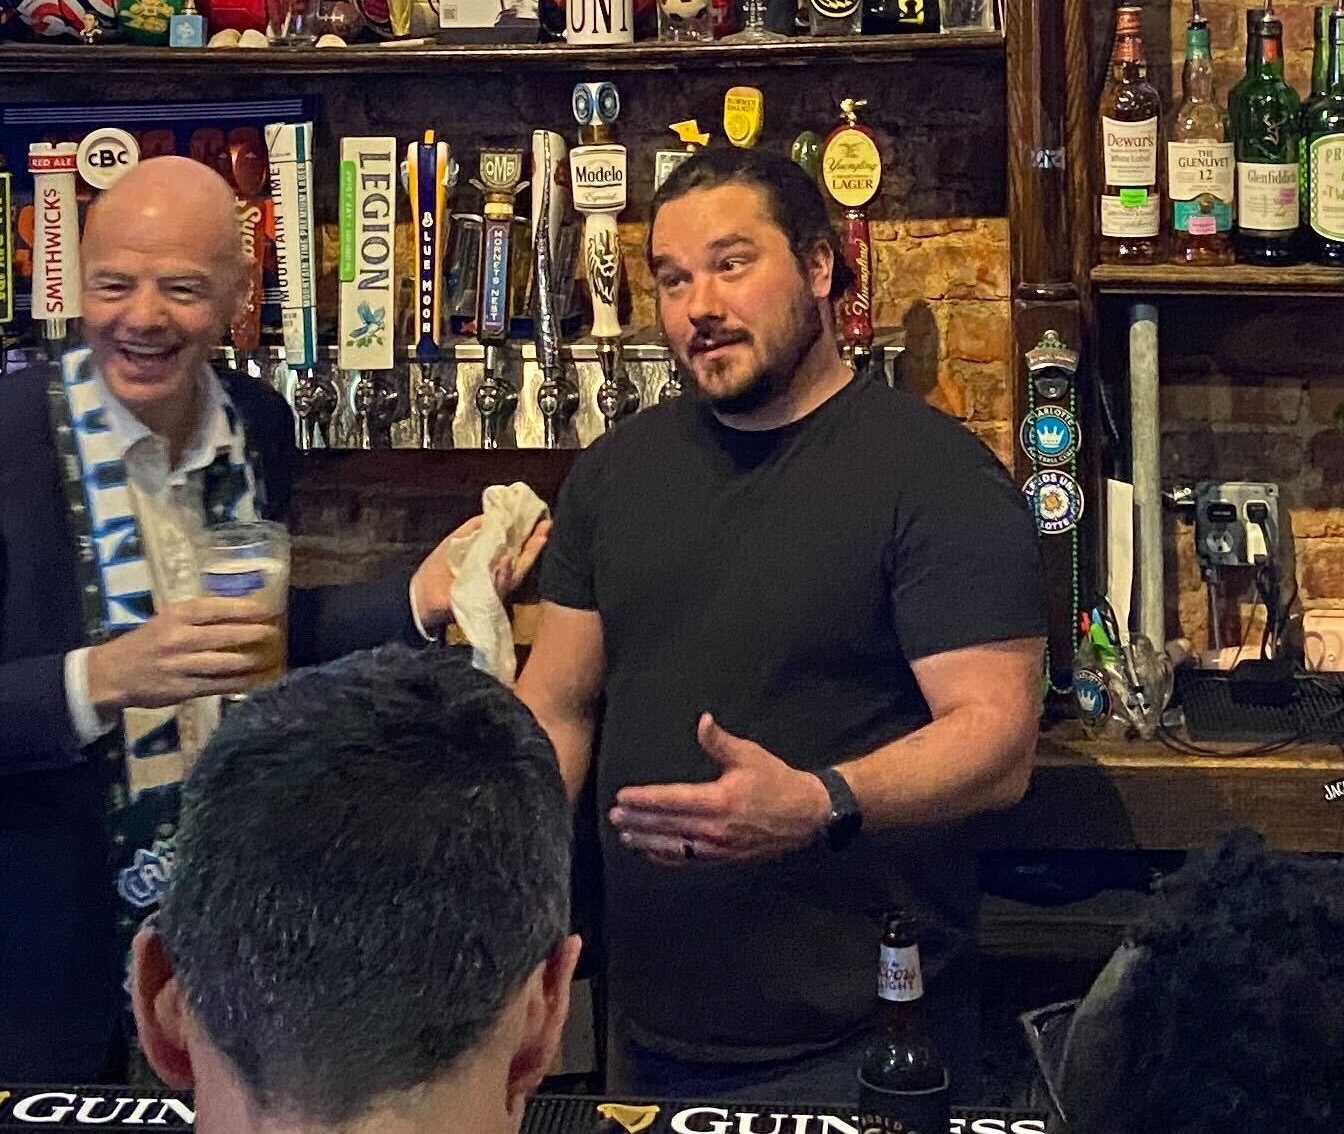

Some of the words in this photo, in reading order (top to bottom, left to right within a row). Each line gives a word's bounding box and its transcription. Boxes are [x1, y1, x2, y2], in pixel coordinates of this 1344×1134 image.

[32, 158, 51, 167] RED
[53, 157, 73, 167] ALE
[88, 149, 129, 168] CBC
[826, 157, 878, 173] Yuengling
[1178, 157, 1230, 168] GLENLIVET
[1197, 150, 1214, 158] THE
[485, 156, 515, 182] OMB
[575, 166, 623, 183] Modelo
[1199, 170, 1213, 181] 12
[1247, 169, 1297, 185] Glenfiddich
[270, 163, 281, 206] TIME
[832, 179, 874, 191] LAGER
[358, 151, 392, 292] LEGION
[421, 211, 434, 271] BLUE
[275, 215, 290, 304] MOUNTAIN
[492, 230, 503, 286] HORNETS
[421, 279, 433, 333] MOON
[490, 289, 501, 321] NEST
[12, 1092, 198, 1125] GUIN
[670, 1107, 1048, 1134] GUINESS
